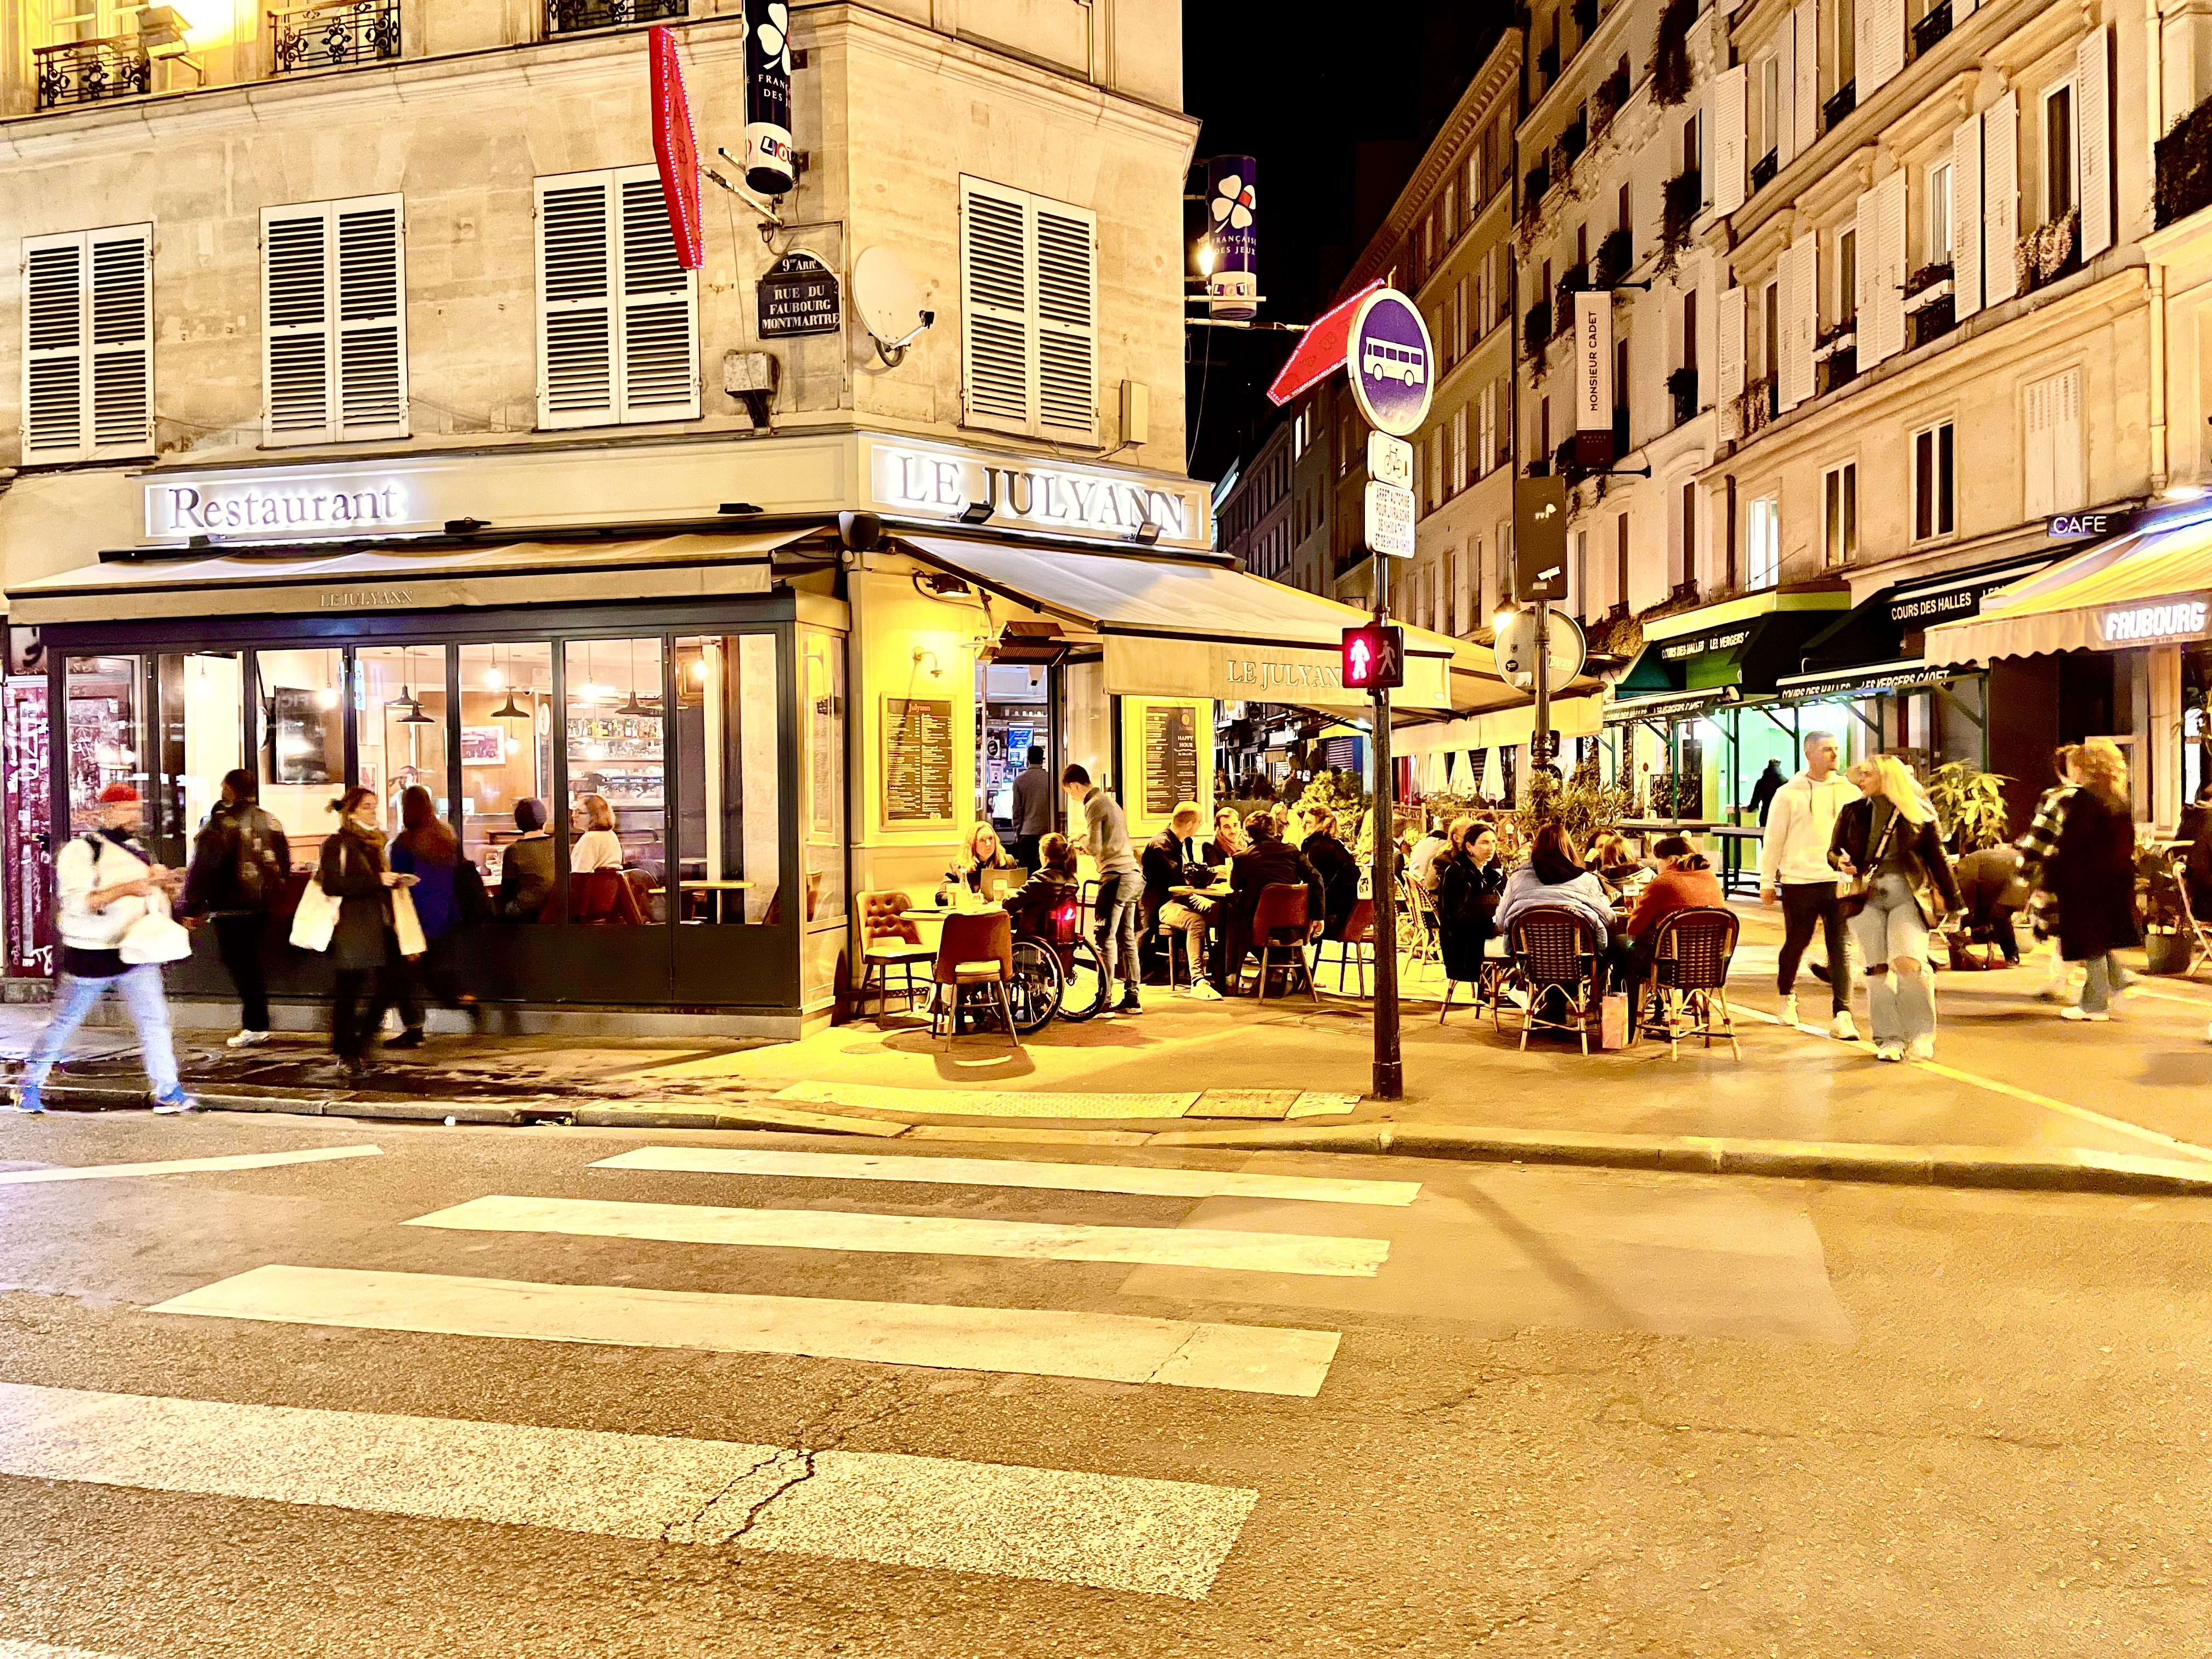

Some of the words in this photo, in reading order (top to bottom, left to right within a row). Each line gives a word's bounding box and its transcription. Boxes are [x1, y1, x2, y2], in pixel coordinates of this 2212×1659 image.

[764, 88, 782, 101] DES
[760, 136, 793, 164] LOT
[1215, 246, 1231, 255] DES
[1234, 246, 1255, 255] JEUX
[774, 287, 800, 300] RUE
[808, 285, 825, 297] DU
[769, 299, 831, 315] FAUBOURG
[762, 313, 839, 329] MONTMARTRE
[1588, 311, 1598, 348] CADET
[1589, 351, 1598, 411] MONSIEUR
[896, 455, 961, 506] LE
[980, 466, 1186, 537] JULYANN
[168, 483, 400, 530] Restaurant
[1376, 502, 1387, 517] POUR
[1387, 505, 1409, 523] LIVRAISONS
[1378, 518, 1383, 532] DE
[2053, 516, 2107, 534] CAFE
[1375, 533, 1380, 546] ET
[1381, 534, 1386, 548] DE
[320, 594, 339, 607] LE
[342, 590, 413, 606] JULYANN
[1891, 602, 1919, 620] COURS
[1920, 599, 1937, 616] DES
[1938, 592, 1972, 612] HALLES
[2105, 601, 2207, 641] FAUBOURG
[1662, 646, 1677, 659] COURS
[1676, 645, 1687, 657] DES
[1686, 640, 1705, 655] HALLES
[1719, 631, 1745, 648] VERGERS
[1227, 660, 1257, 684] LE
[1260, 662, 1344, 691] JULYAN
[1876, 674, 1916, 689] VERGERS
[908, 703, 931, 713] Julyann
